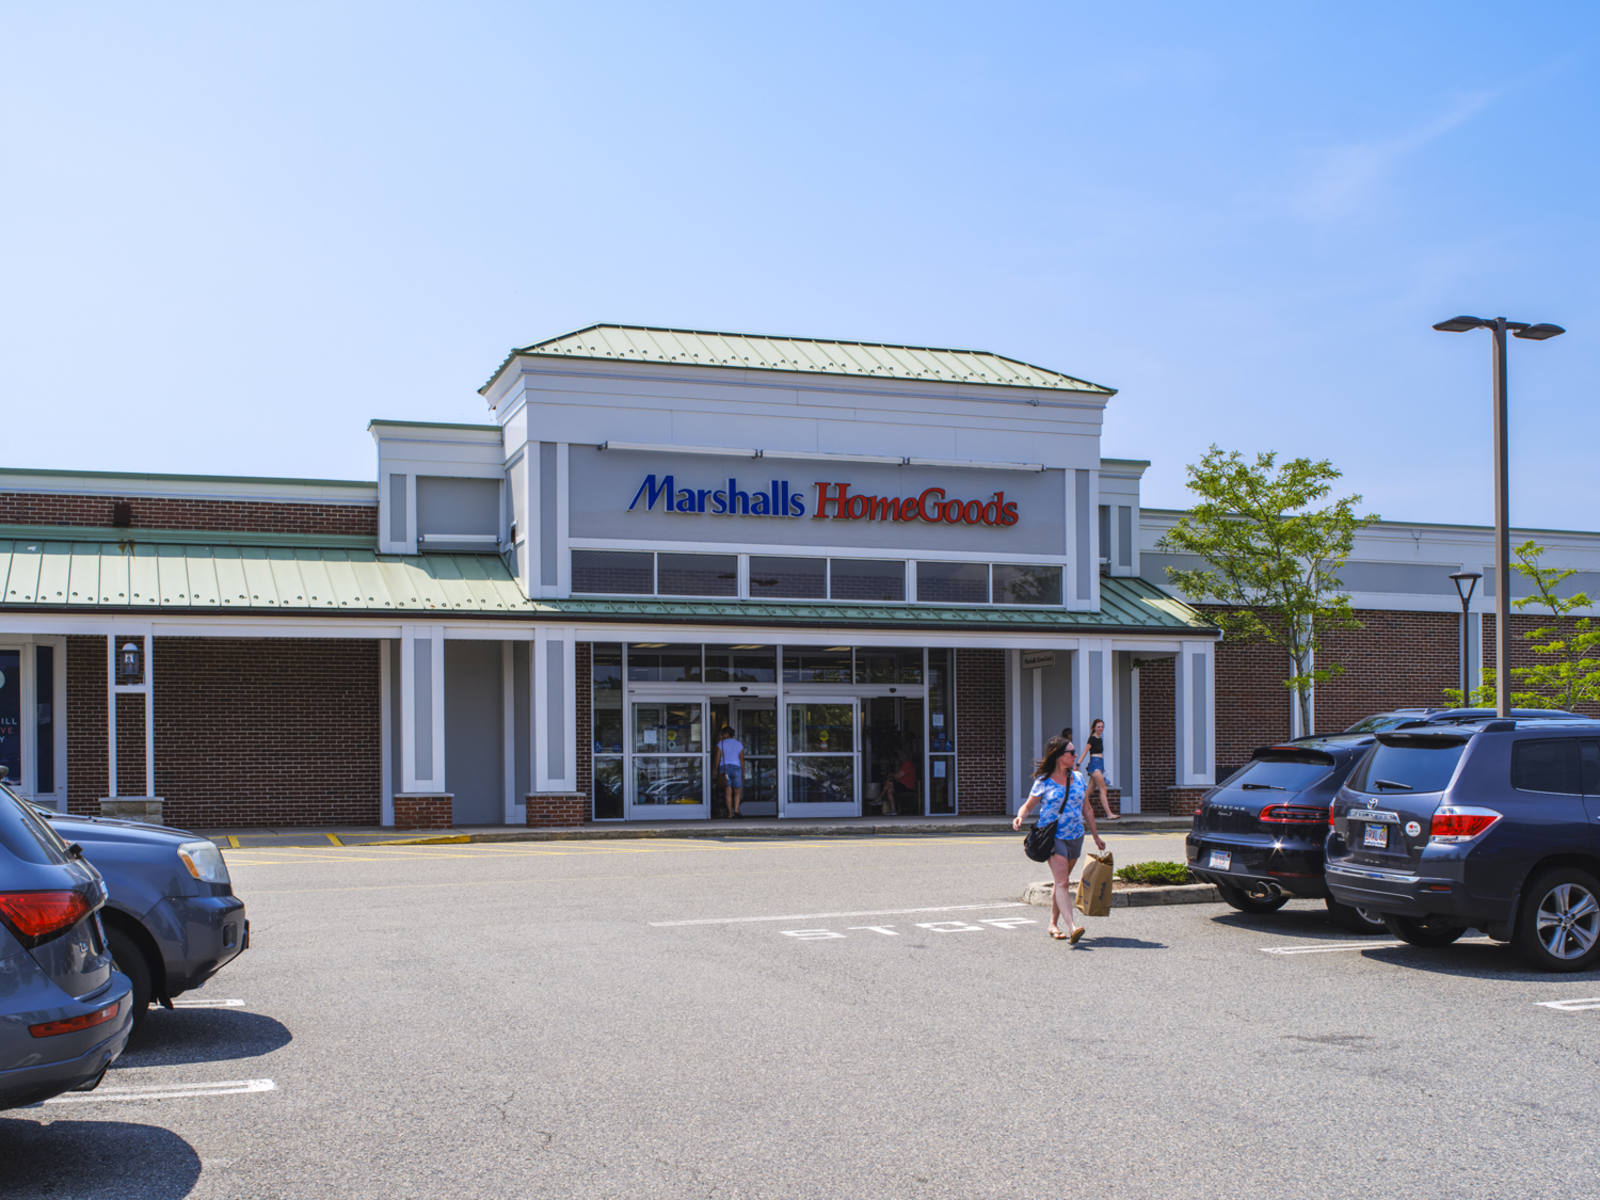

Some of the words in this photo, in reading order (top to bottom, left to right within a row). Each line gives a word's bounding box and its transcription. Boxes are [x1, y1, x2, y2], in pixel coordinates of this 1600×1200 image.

[628, 474, 805, 517] Marshalls
[812, 481, 1019, 527] HomeGoods
[779, 916, 1038, 940] STOP
